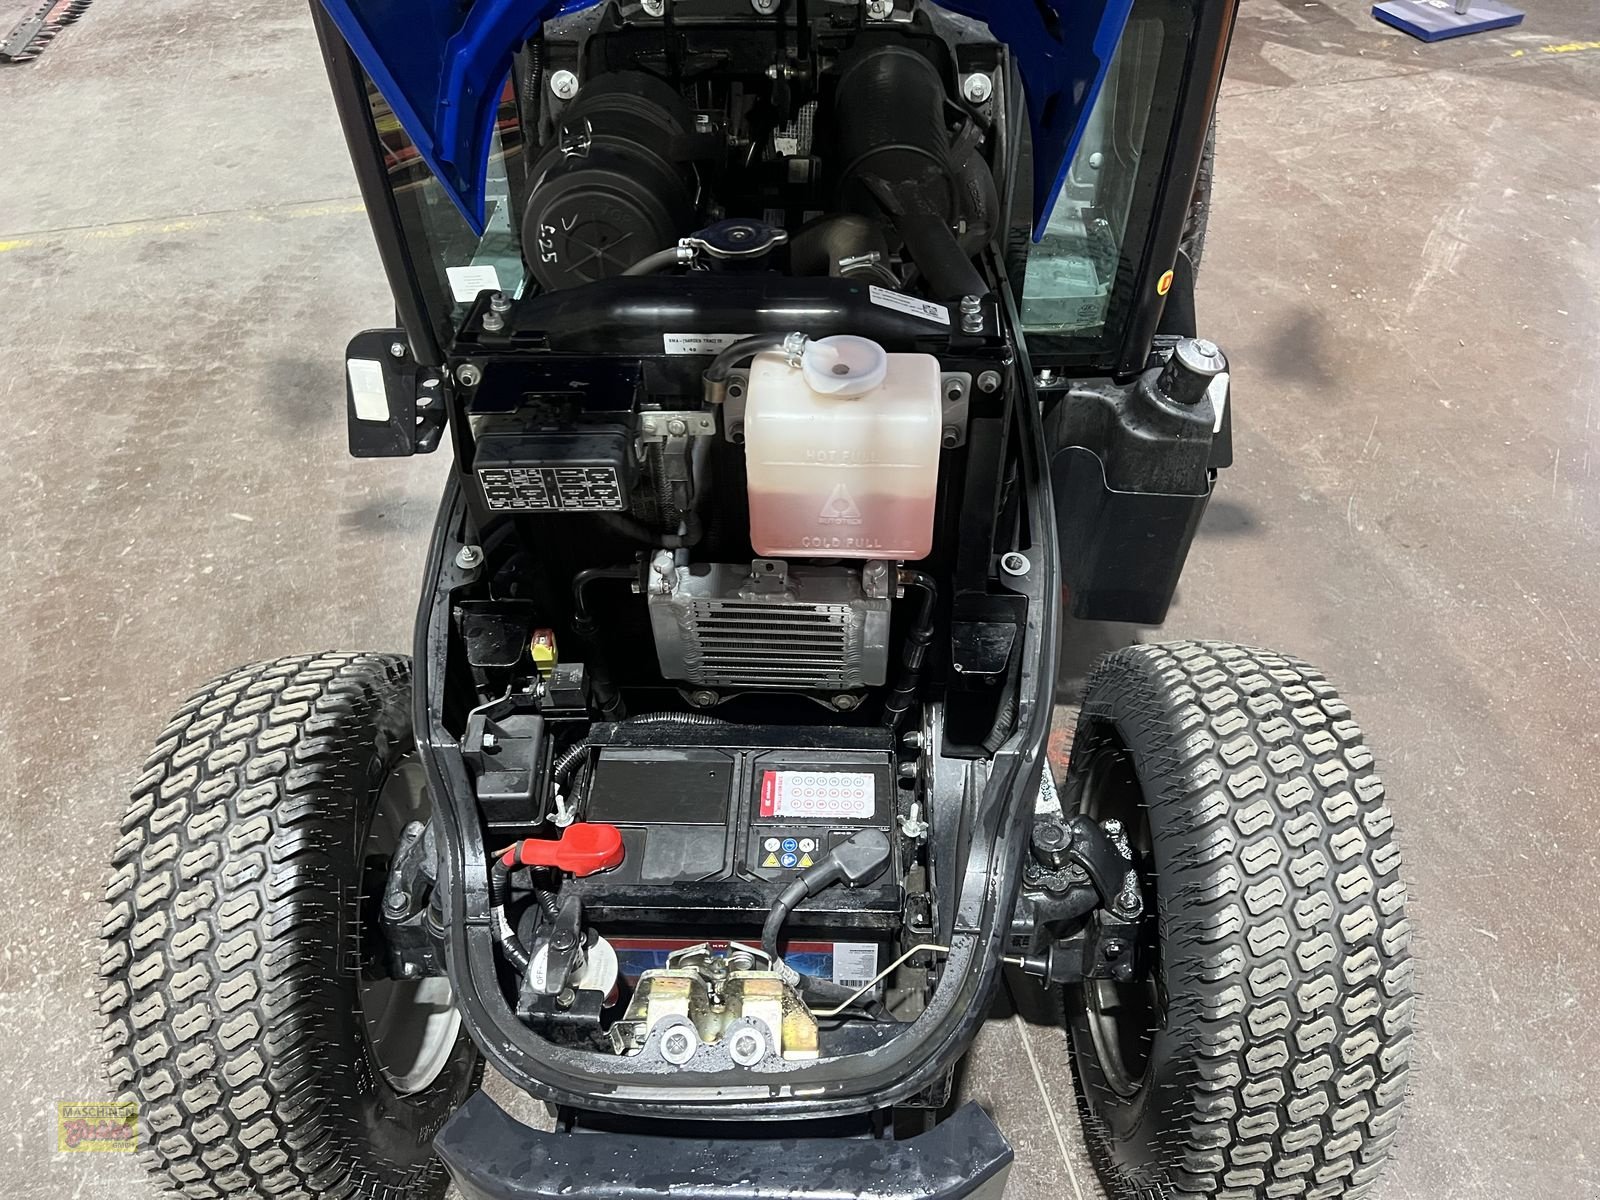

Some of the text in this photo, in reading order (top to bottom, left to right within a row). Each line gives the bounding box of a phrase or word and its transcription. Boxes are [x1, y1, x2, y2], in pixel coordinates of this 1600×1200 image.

[806, 449, 880, 462] HOT FULL
[801, 536, 883, 548] COLD FULL
